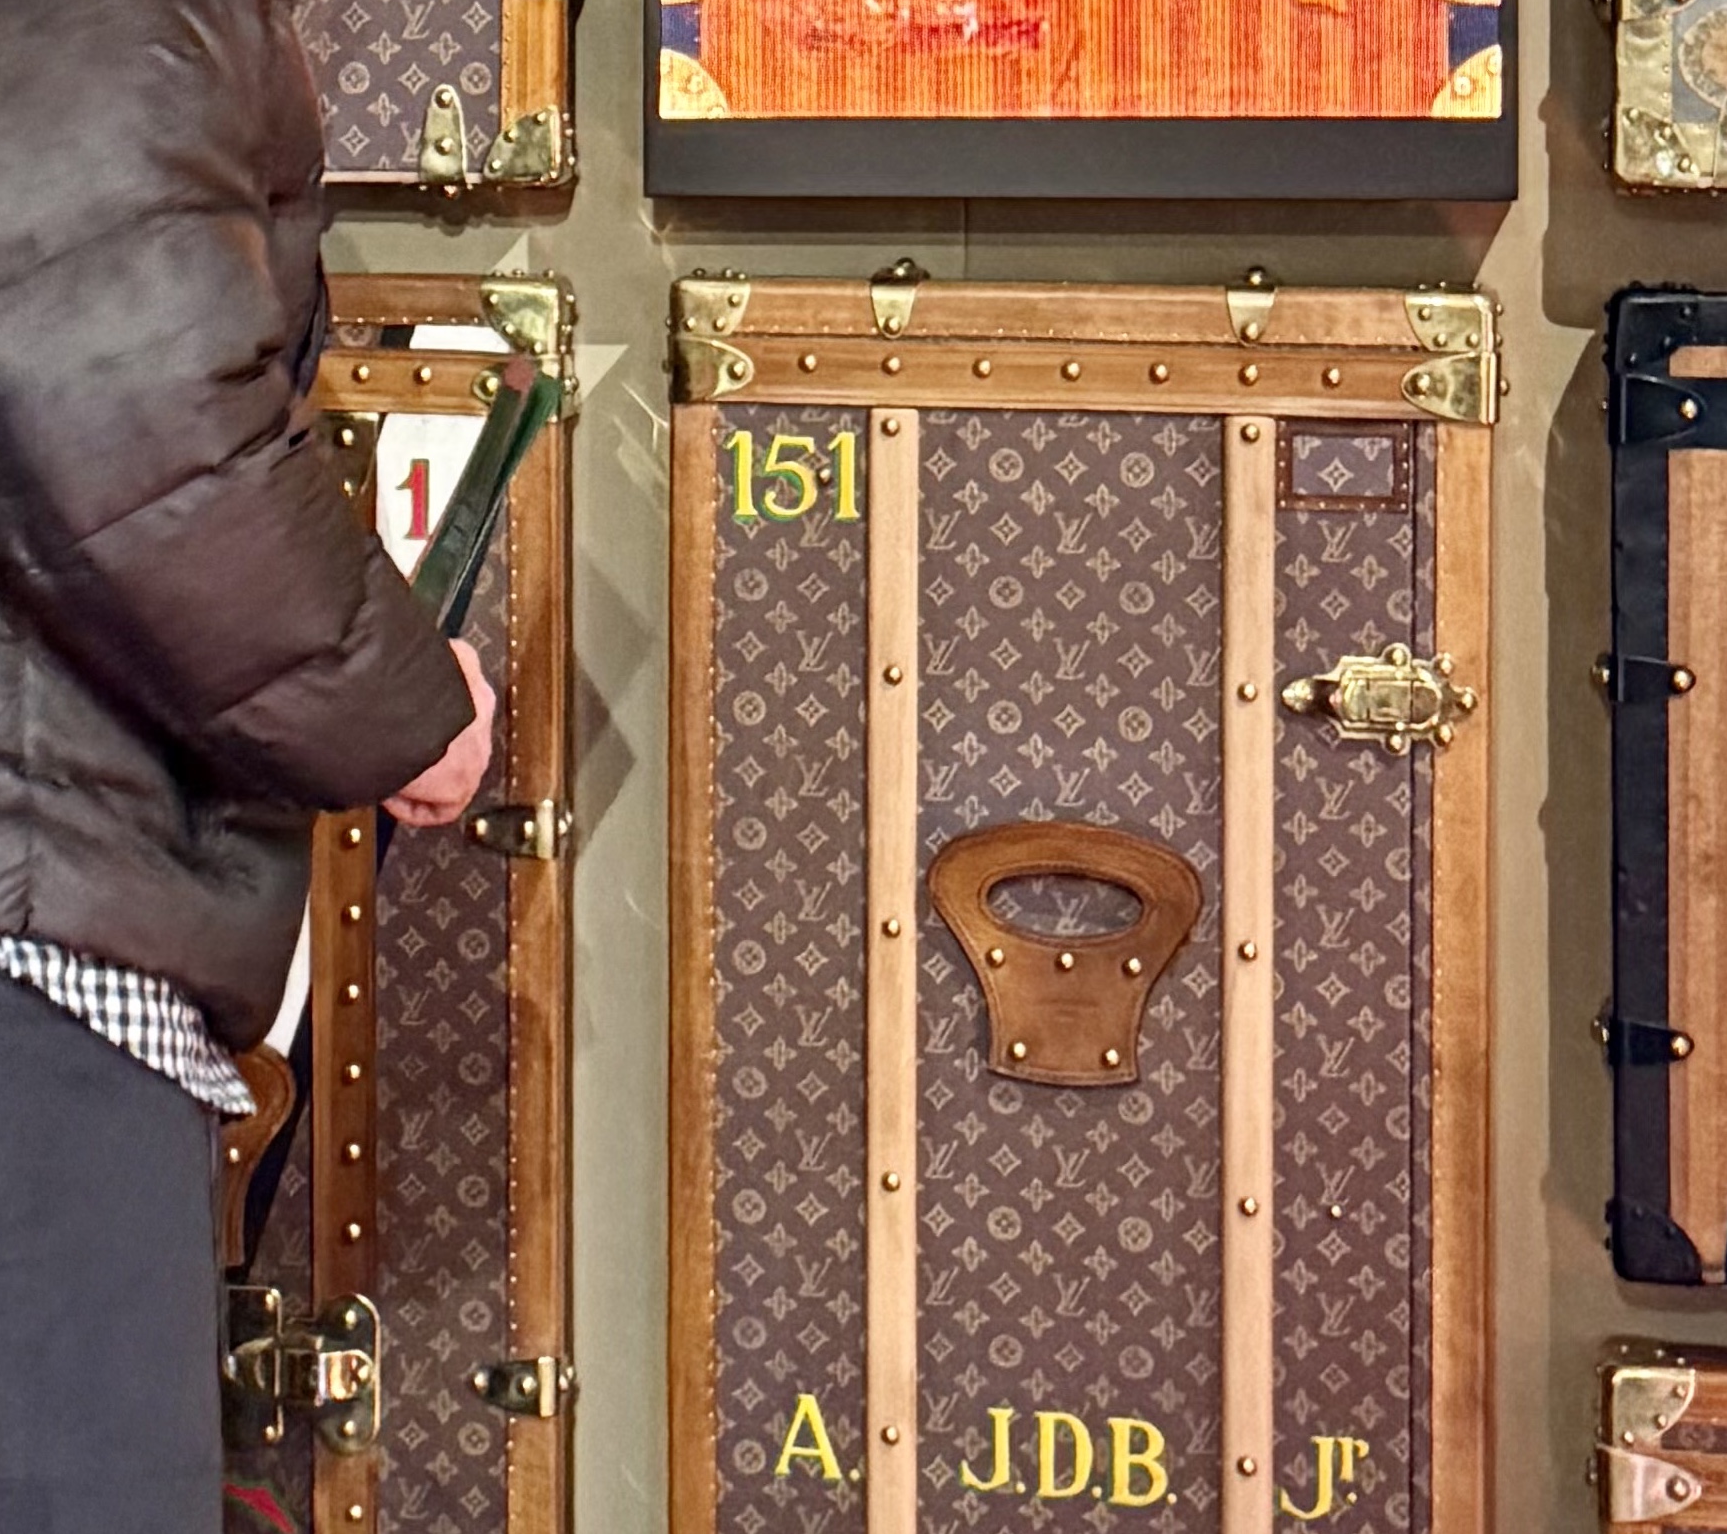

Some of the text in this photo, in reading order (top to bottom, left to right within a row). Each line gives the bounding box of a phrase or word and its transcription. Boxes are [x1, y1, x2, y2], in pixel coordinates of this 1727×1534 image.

[724, 430, 861, 522] 151
[775, 1392, 861, 1480] A.
[960, 1406, 1178, 1507] J.D.B.
